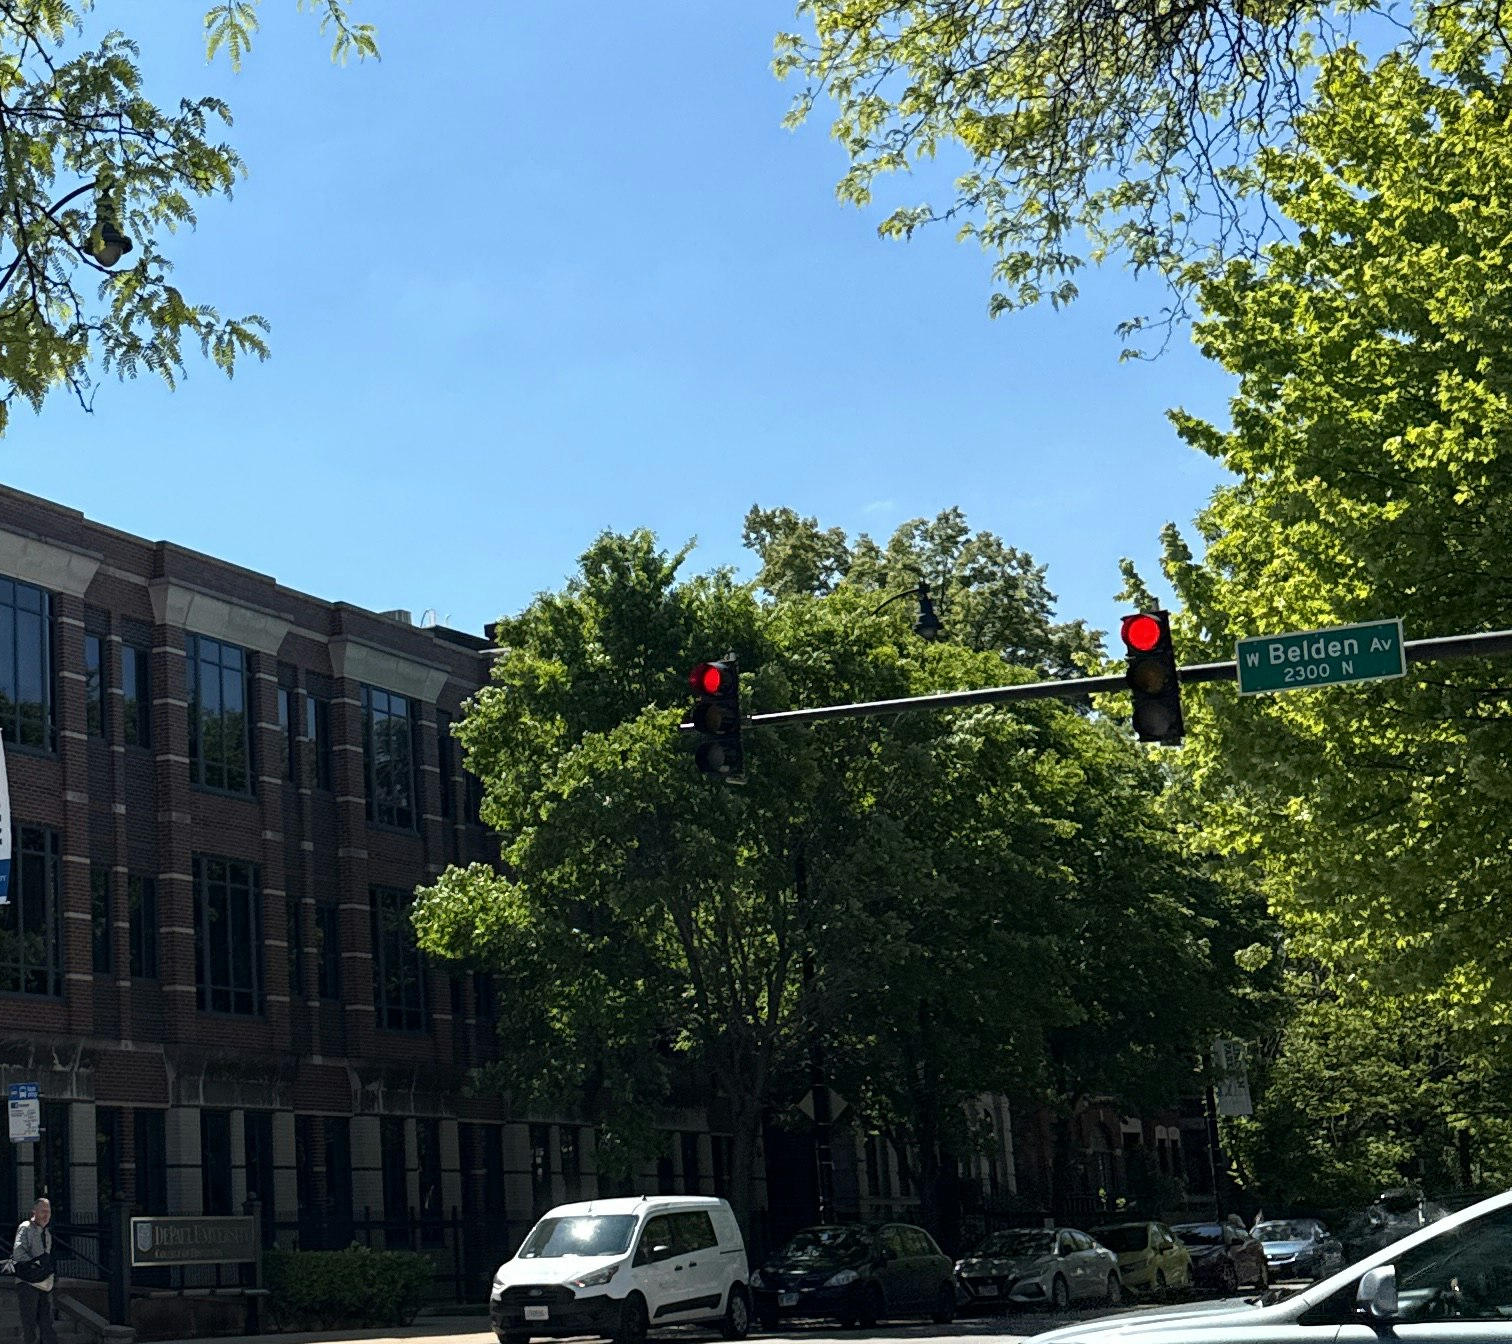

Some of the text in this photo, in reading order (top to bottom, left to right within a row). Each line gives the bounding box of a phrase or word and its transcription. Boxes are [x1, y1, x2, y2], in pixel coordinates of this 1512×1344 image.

[1246, 637, 1392, 667] W Belden Av
[1283, 660, 1354, 682] 2300 N
